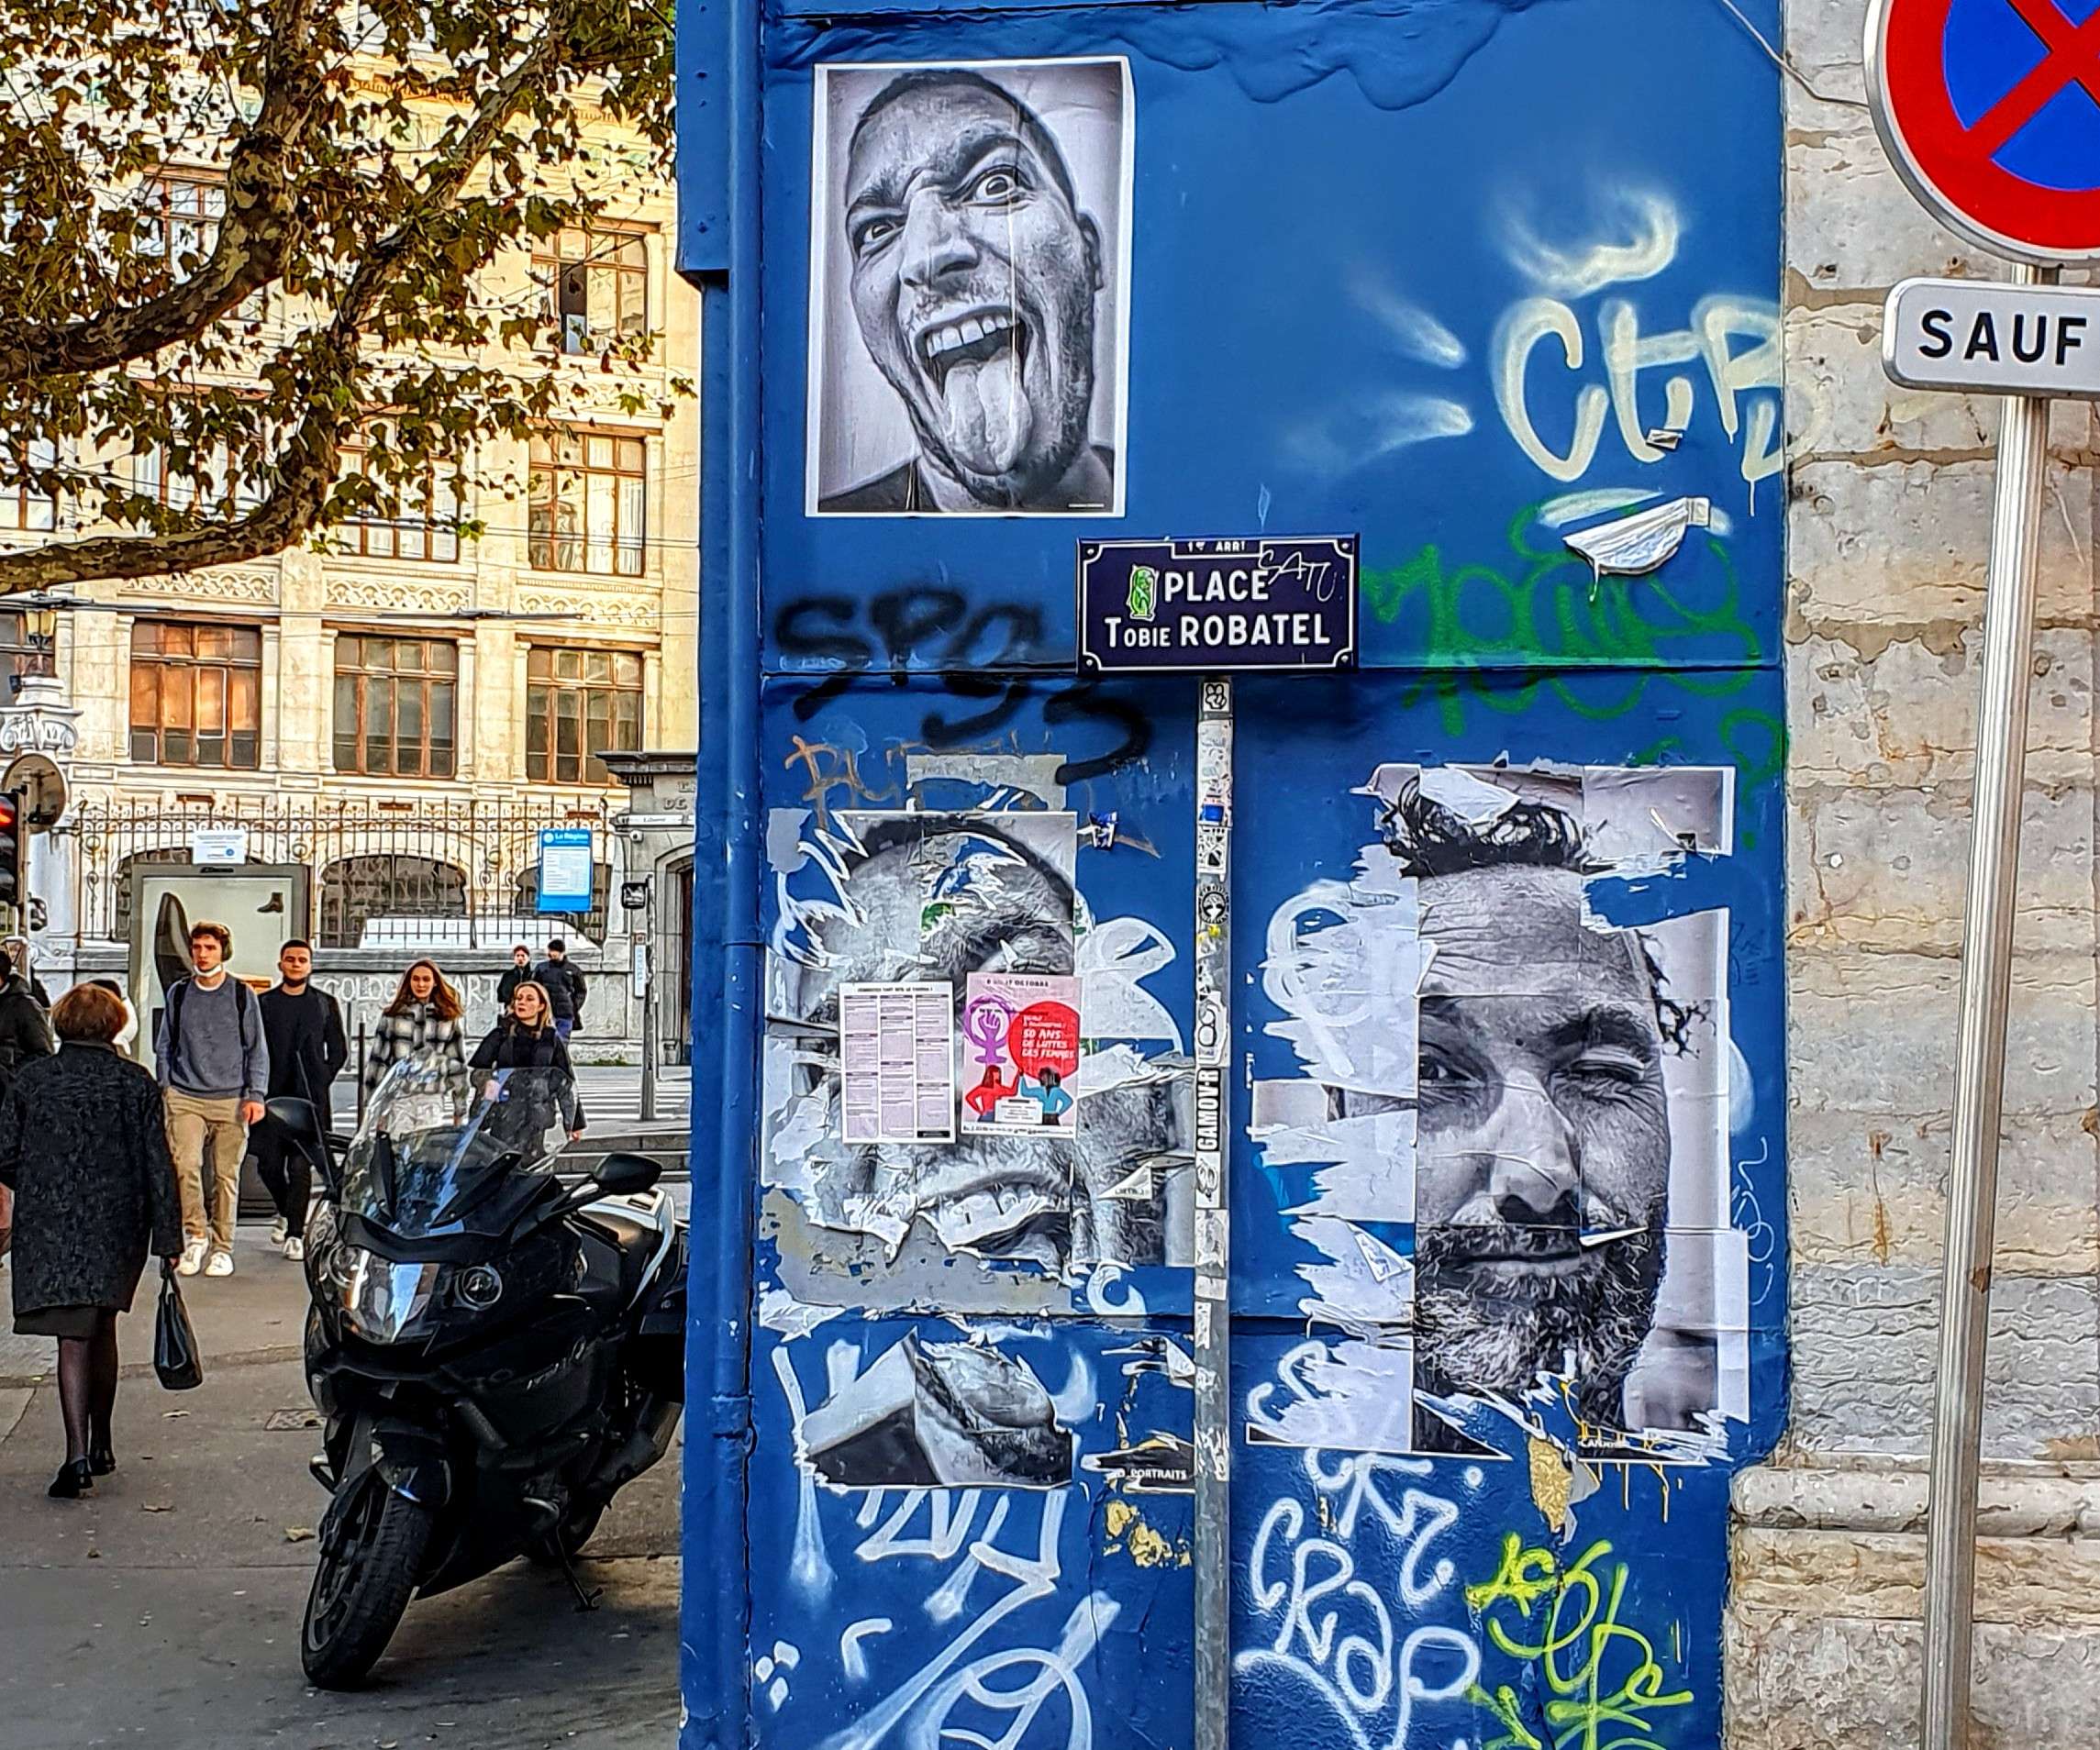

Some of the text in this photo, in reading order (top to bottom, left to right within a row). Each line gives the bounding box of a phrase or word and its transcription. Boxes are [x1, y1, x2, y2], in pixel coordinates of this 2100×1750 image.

[1918, 309, 2087, 365] SAUF
[1164, 570, 1270, 602] PLACE
[1181, 614, 1330, 646] ROBATEL
[1038, 1028, 1061, 1039] ANS
